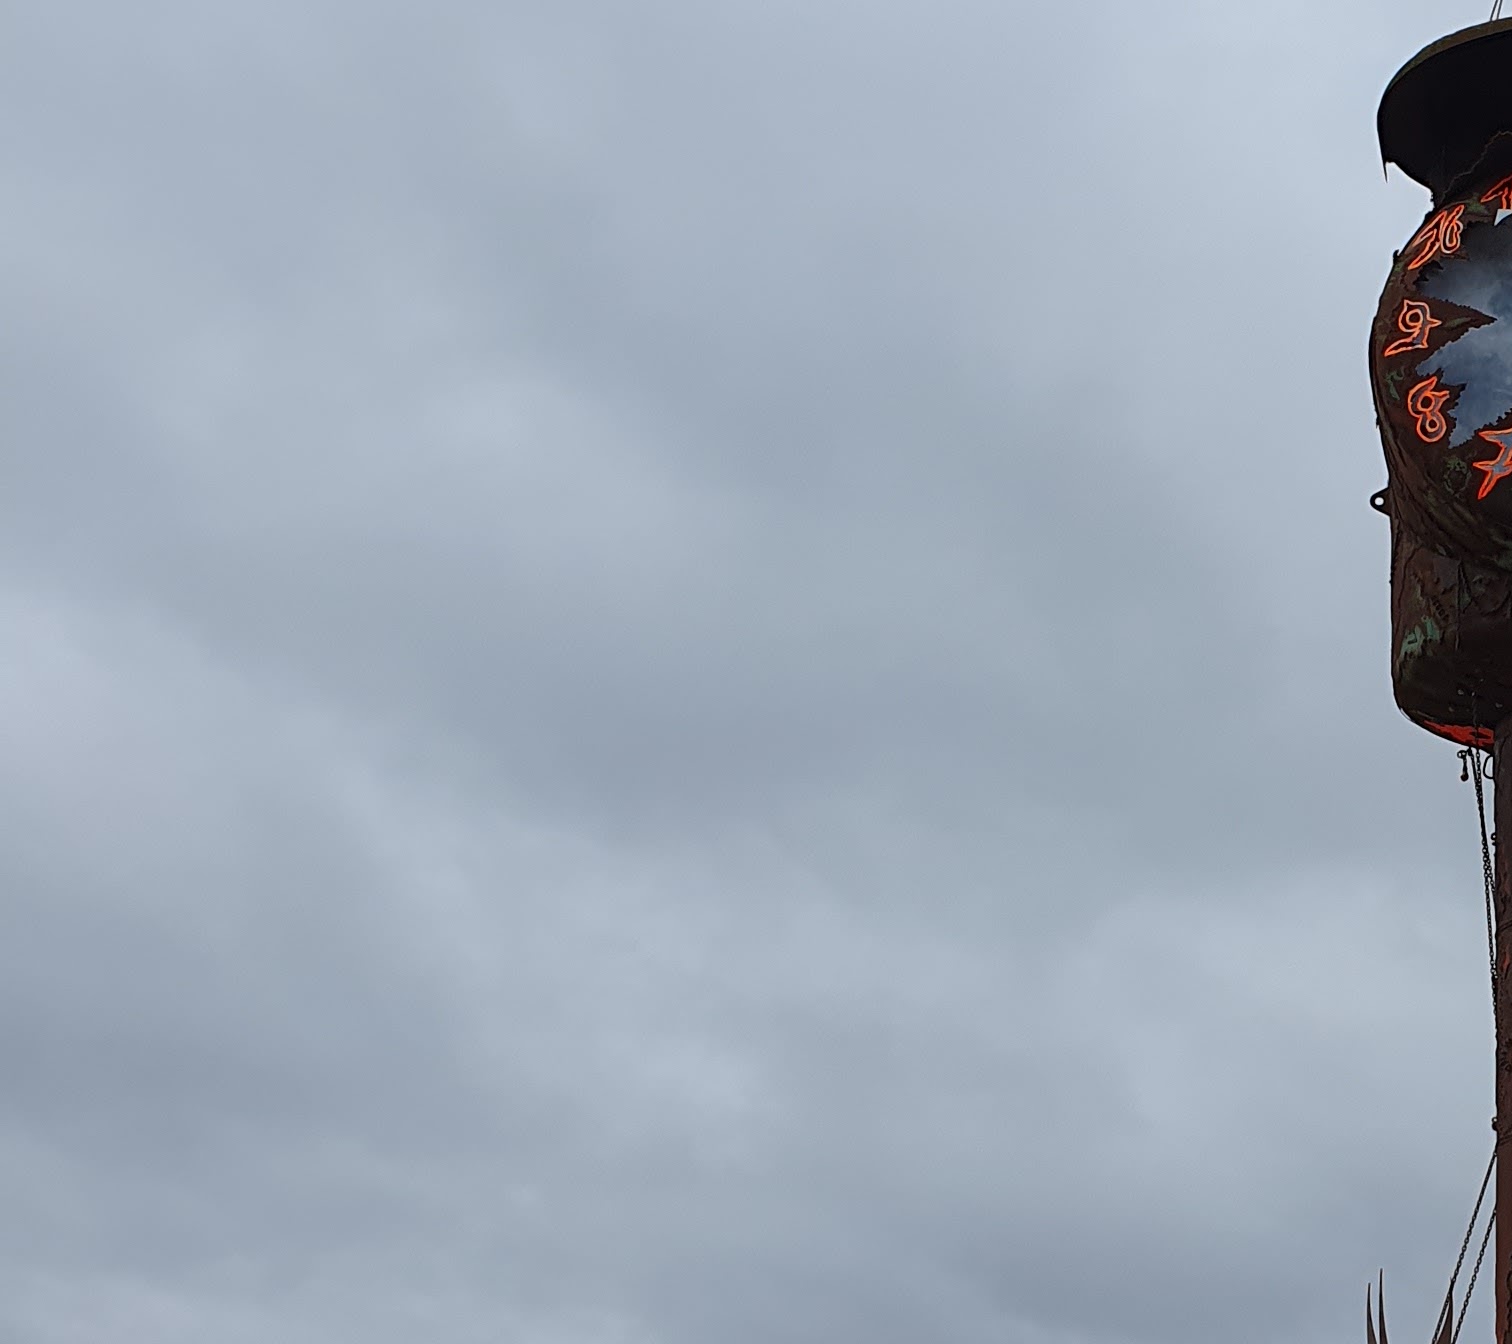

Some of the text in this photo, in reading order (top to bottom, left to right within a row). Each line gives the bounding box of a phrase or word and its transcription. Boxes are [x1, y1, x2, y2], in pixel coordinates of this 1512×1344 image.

[1407, 204, 1464, 269] 10
[1383, 299, 1442, 357] 9
[1407, 376, 1450, 442] 8
